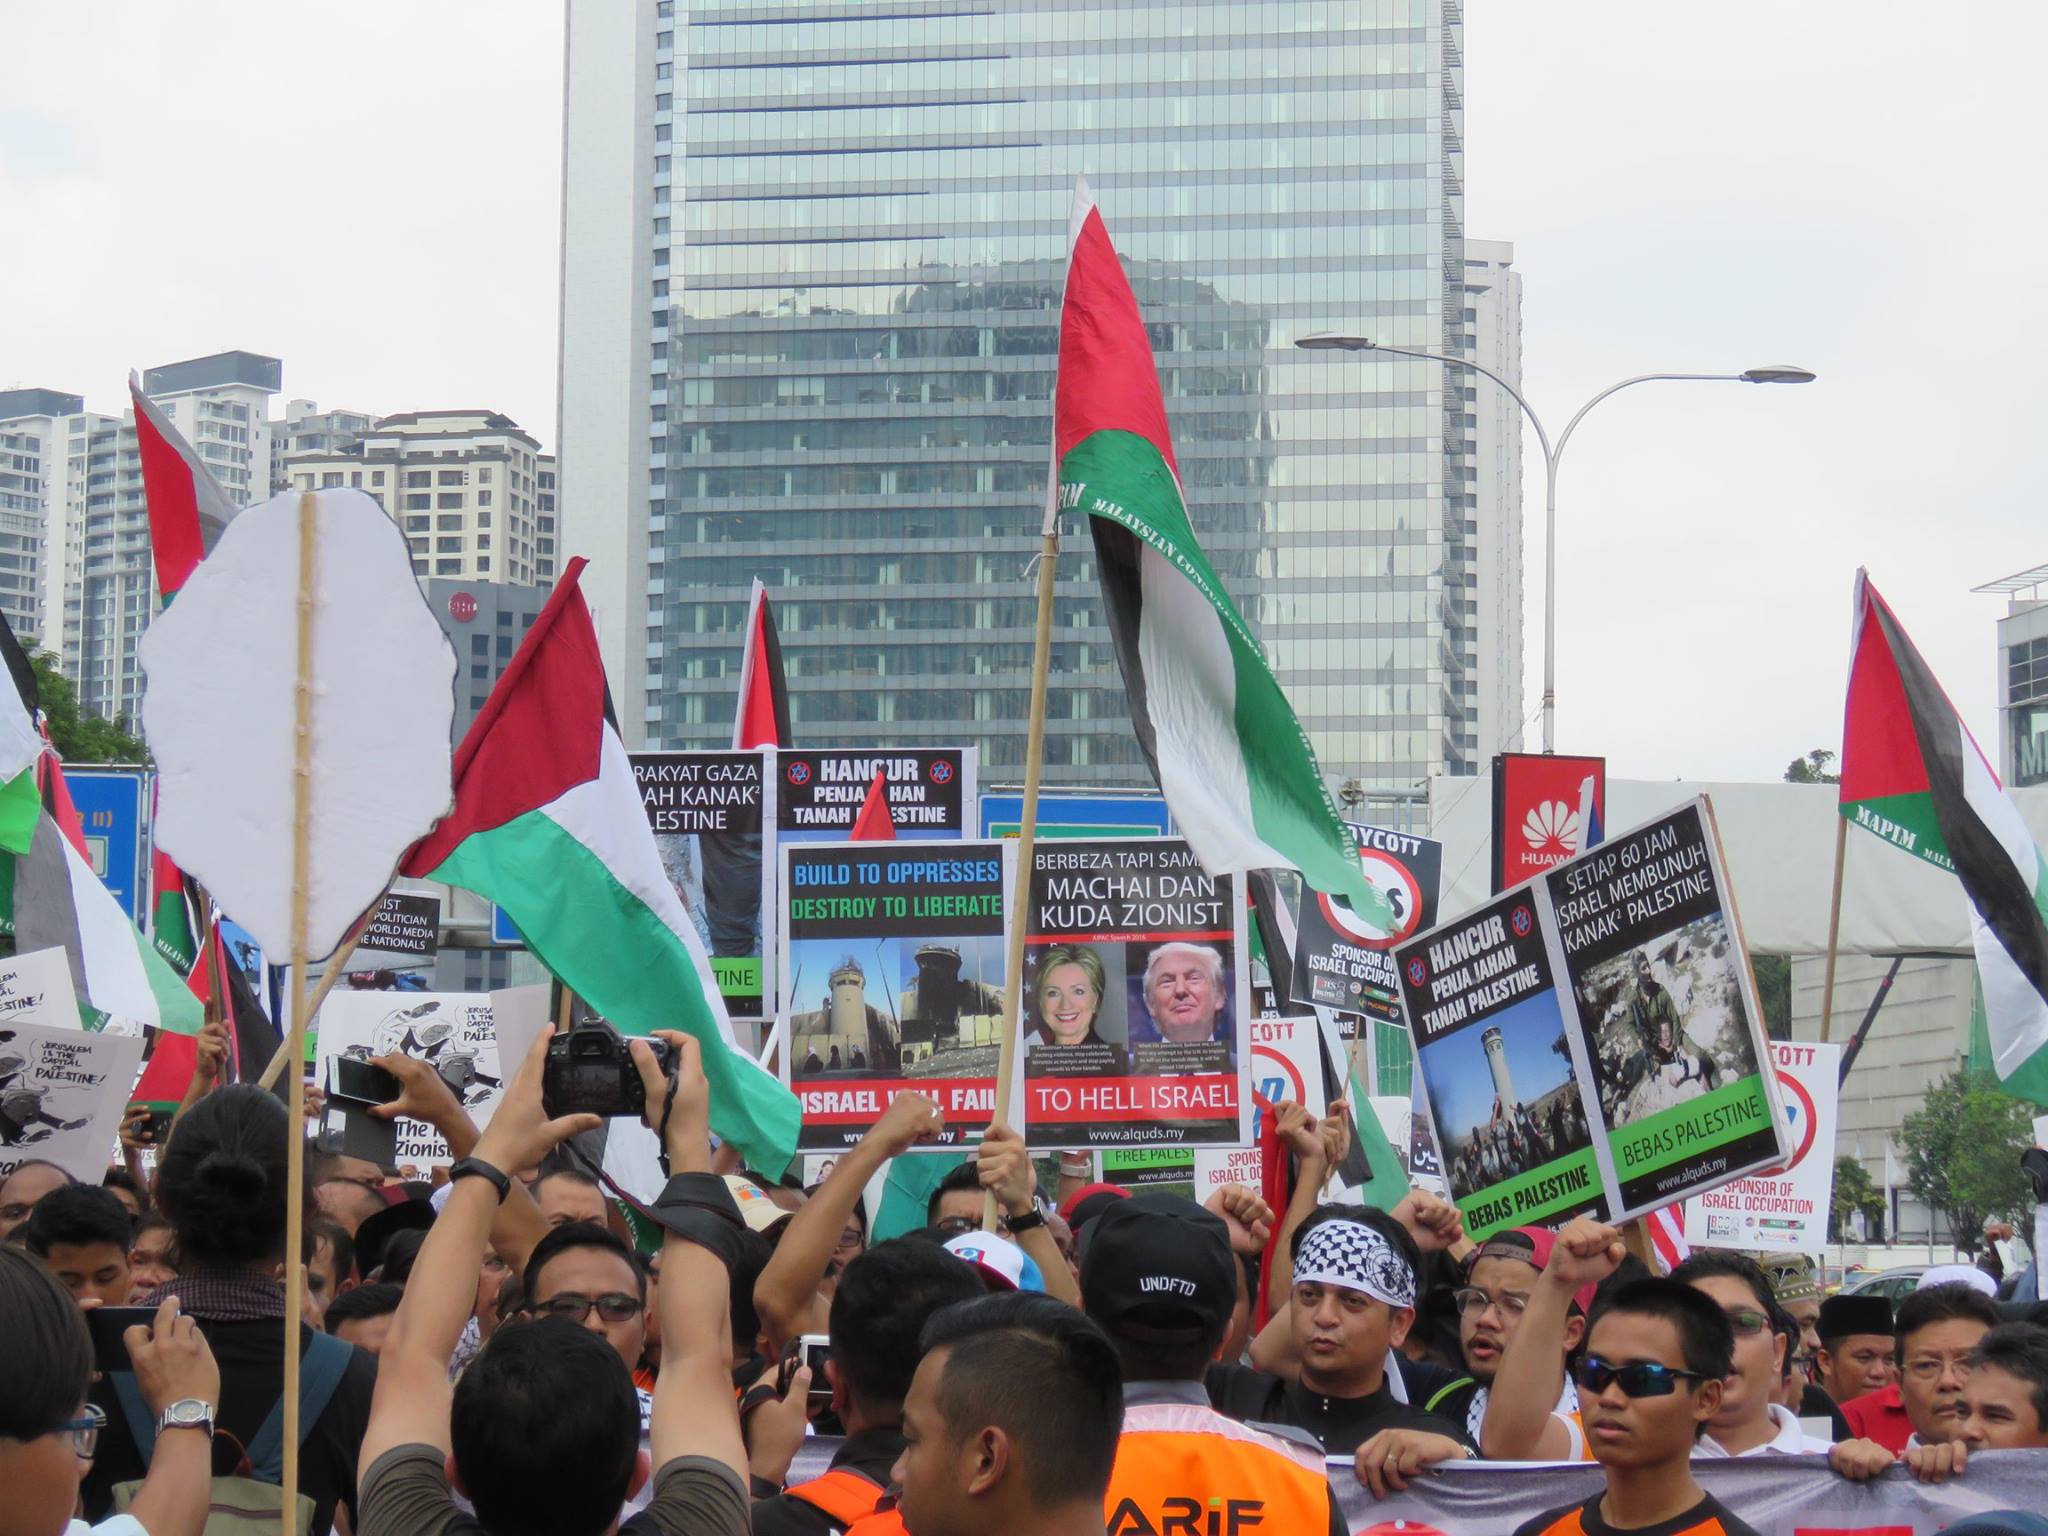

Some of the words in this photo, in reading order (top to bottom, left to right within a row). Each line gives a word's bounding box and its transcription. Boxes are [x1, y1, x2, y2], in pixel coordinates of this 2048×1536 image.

[1092, 498, 1177, 557] MALAYSIAN
[634, 765, 702, 782] RAKYAT
[706, 763, 757, 781] GAZA
[794, 807, 851, 825] TANAH
[1856, 804, 1917, 850] MAPIM
[1035, 853, 1113, 870] BERBEZA
[1116, 852, 1154, 869] TAPI
[1159, 851, 1201, 867] SAM
[1566, 853, 1617, 895] SETIAP
[1620, 843, 1640, 868] 60
[1644, 825, 1679, 860] JAM
[794, 864, 850, 886] BUILD
[856, 863, 880, 885] TO
[887, 861, 1000, 884] OPPRESSES
[1555, 888, 1608, 929] ISRAEL
[1608, 841, 1707, 904] MEMBUNUH
[1047, 876, 1150, 900] MACHAI
[1160, 876, 1215, 899] DAN
[1627, 869, 1711, 925] PALESTINE
[374, 911, 428, 926] POLITICIAN
[791, 898, 877, 919] DESTROY
[882, 896, 906, 918] TO
[914, 895, 1002, 917] LIBERATE
[1041, 904, 1114, 928] KUDA
[1121, 902, 1223, 926] ZIONIST
[371, 936, 426, 950] NATIONALS
[402, 927, 434, 939] MEDIA
[1428, 914, 1506, 974] HANCUR
[1308, 954, 1349, 976] ISRAEL
[1331, 943, 1382, 968] SPONSOR
[1422, 997, 1468, 1034] TANAH
[1467, 963, 1541, 1014] PALESTINE
[42, 1042, 92, 1054] JERUSALEM
[56, 1051, 76, 1059] THE
[42, 1057, 81, 1067] CAPITAL
[800, 1090, 880, 1114] ISRAEL
[1036, 1088, 1072, 1111] TO
[1080, 1087, 1143, 1110] HELL
[1152, 1084, 1238, 1108] ISRAEL
[396, 1120, 428, 1137] The
[1088, 1127, 1185, 1142] www.alquds.my
[1622, 1128, 1673, 1167] BEBAS
[1676, 1095, 1761, 1148] PALESTINE
[1115, 1149, 1148, 1163] FREE
[1208, 1168, 1247, 1184] ISRAEL
[1656, 1157, 1727, 1192] www.alquds.my
[1467, 1203, 1513, 1232] BEBAS
[1517, 1164, 1590, 1213] PALESTINE
[1724, 1180, 1777, 1196] SPONSOR
[1780, 1182, 1794, 1196] OF
[1702, 1193, 1741, 1210] ISRAEL
[1745, 1197, 1813, 1214] OCCUPATION
[1140, 1277, 1196, 1296] UNDFTD
